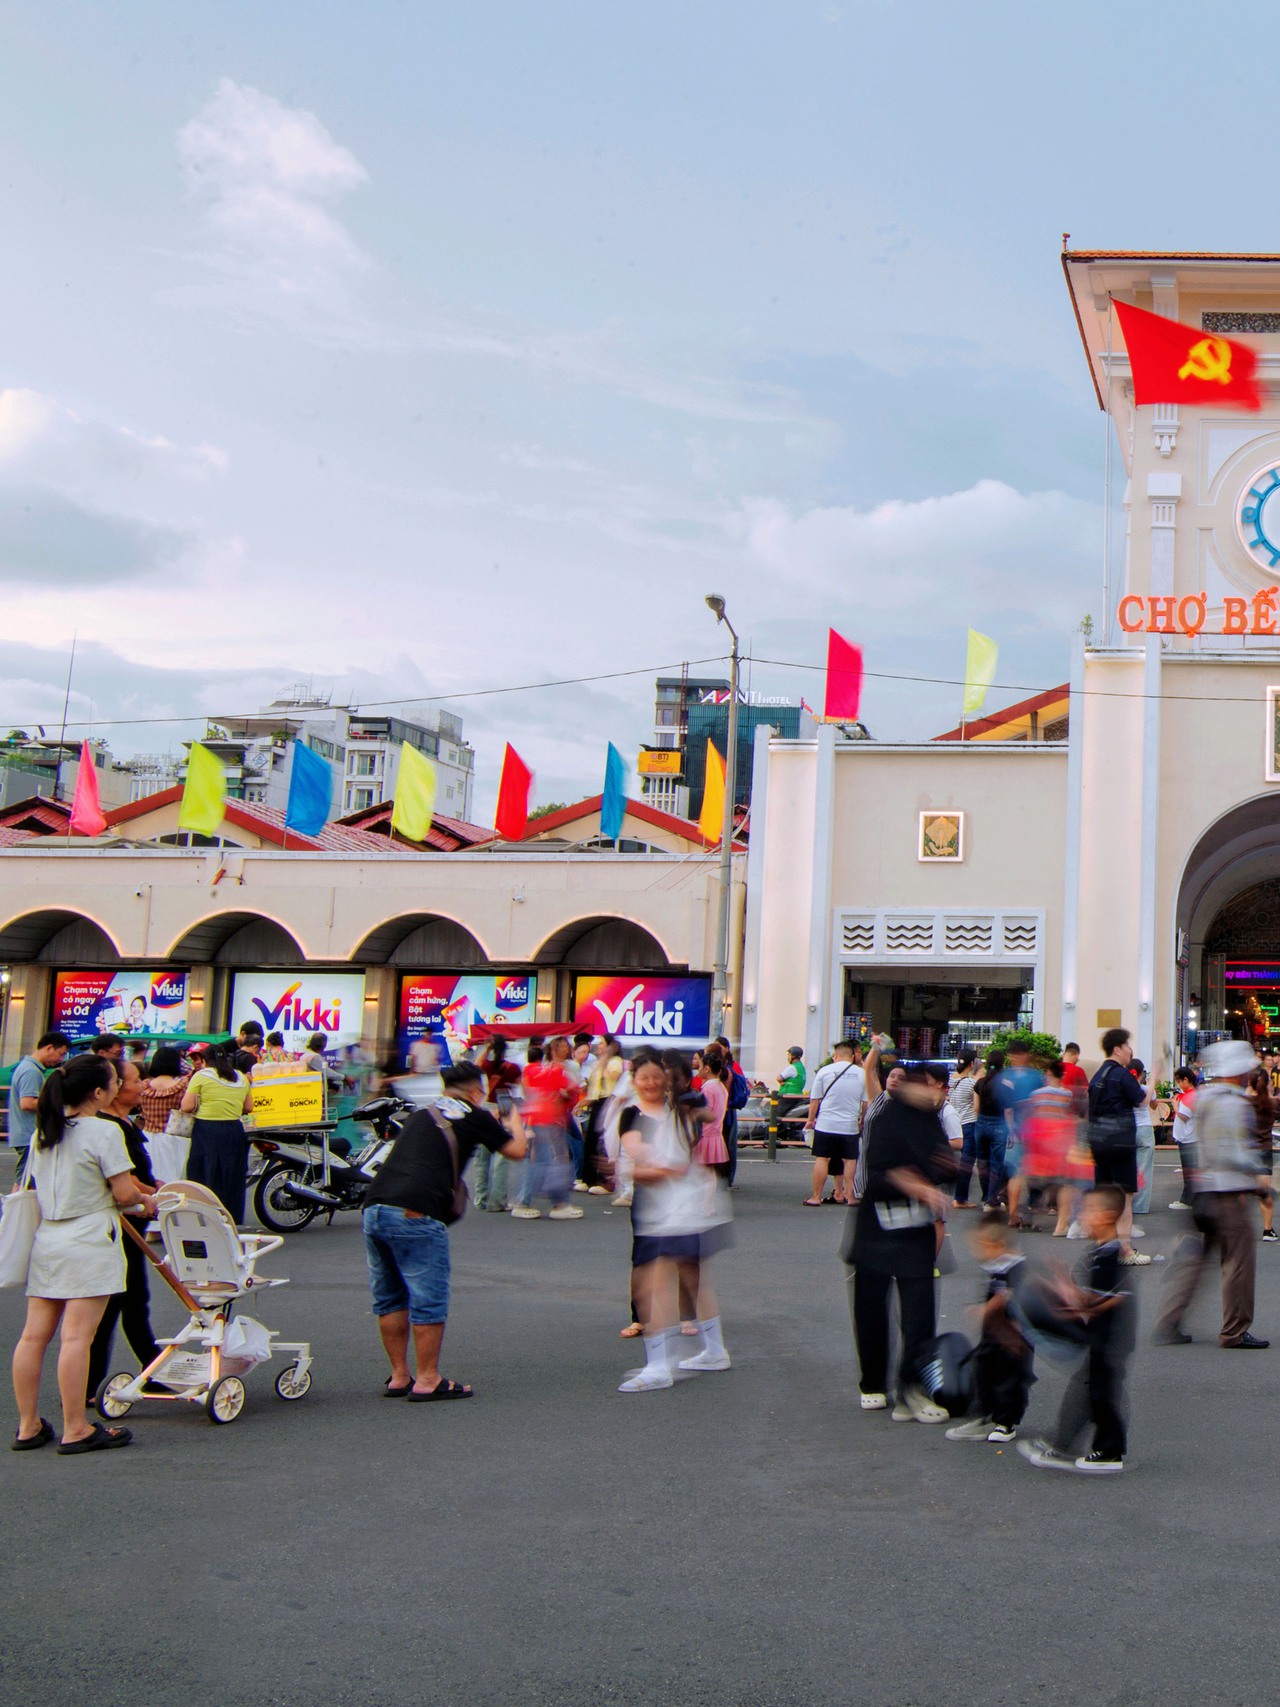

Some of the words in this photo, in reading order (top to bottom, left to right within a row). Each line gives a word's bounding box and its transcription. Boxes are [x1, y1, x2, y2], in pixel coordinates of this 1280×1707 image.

[1242, 506, 1257, 524] 9
[1116, 591, 1208, 638] CHỢ
[64, 986, 88, 995] Chạm
[89, 987, 104, 995] tay,
[152, 978, 183, 996] Vikki
[410, 987, 432, 996] Chạm
[496, 981, 527, 999] Vikki
[252, 982, 342, 1031] Vikki
[593, 984, 684, 1035] Vikki
